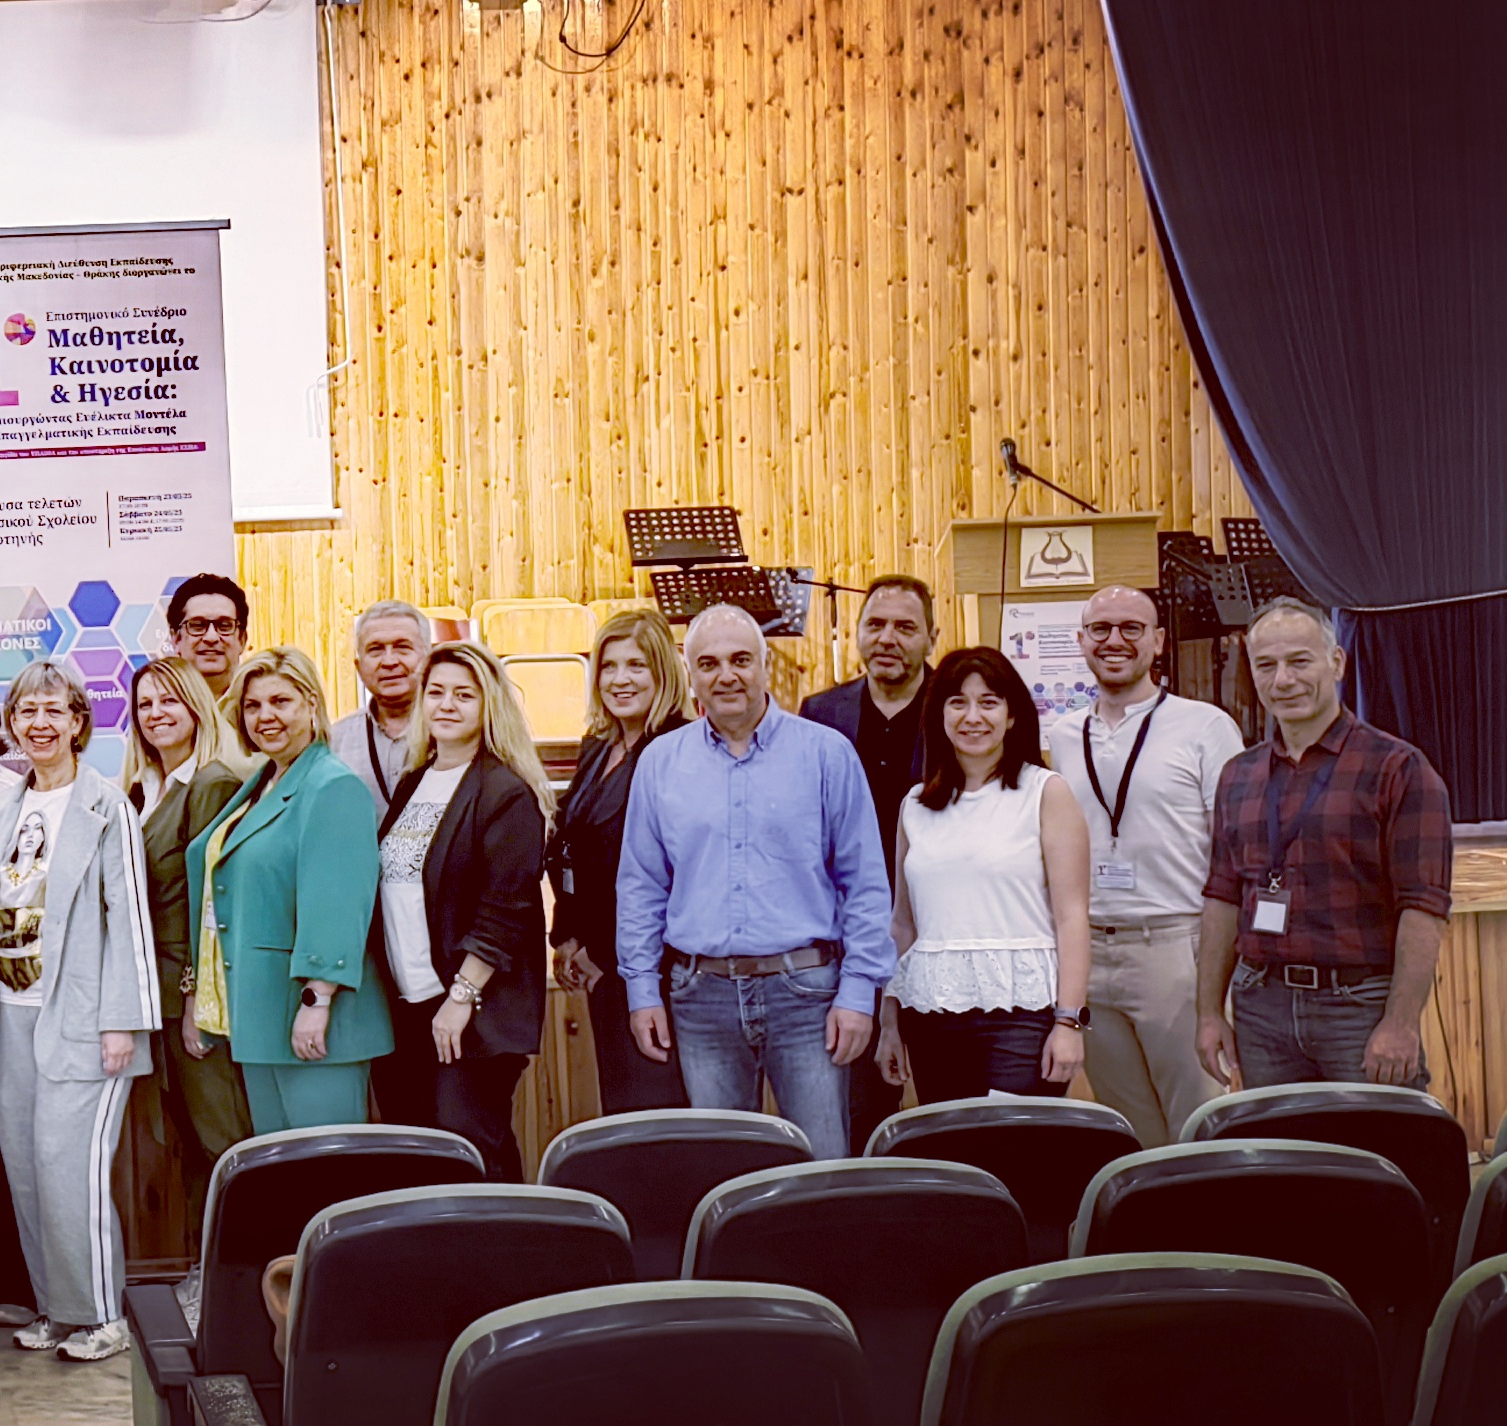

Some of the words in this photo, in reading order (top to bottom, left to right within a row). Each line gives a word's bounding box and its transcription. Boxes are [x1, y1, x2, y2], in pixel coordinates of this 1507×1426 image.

[83, 269, 120, 279] Θράκης
[45, 308, 129, 323] Επιστημονικό
[132, 306, 187, 320] Συνέδριο
[47, 323, 185, 350] Μαθητεία,
[48, 350, 200, 377] Καινοτομία
[50, 384, 70, 403] &
[78, 380, 178, 407] Ηγεσία:
[75, 409, 131, 423] Ευέλικτα
[134, 408, 187, 420] Μοντέλα
[96, 423, 177, 438] Εκπαίδευσης
[28, 497, 82, 511] τελετών
[37, 513, 98, 529] Σχολείου
[87, 687, 124, 702] θητεία
